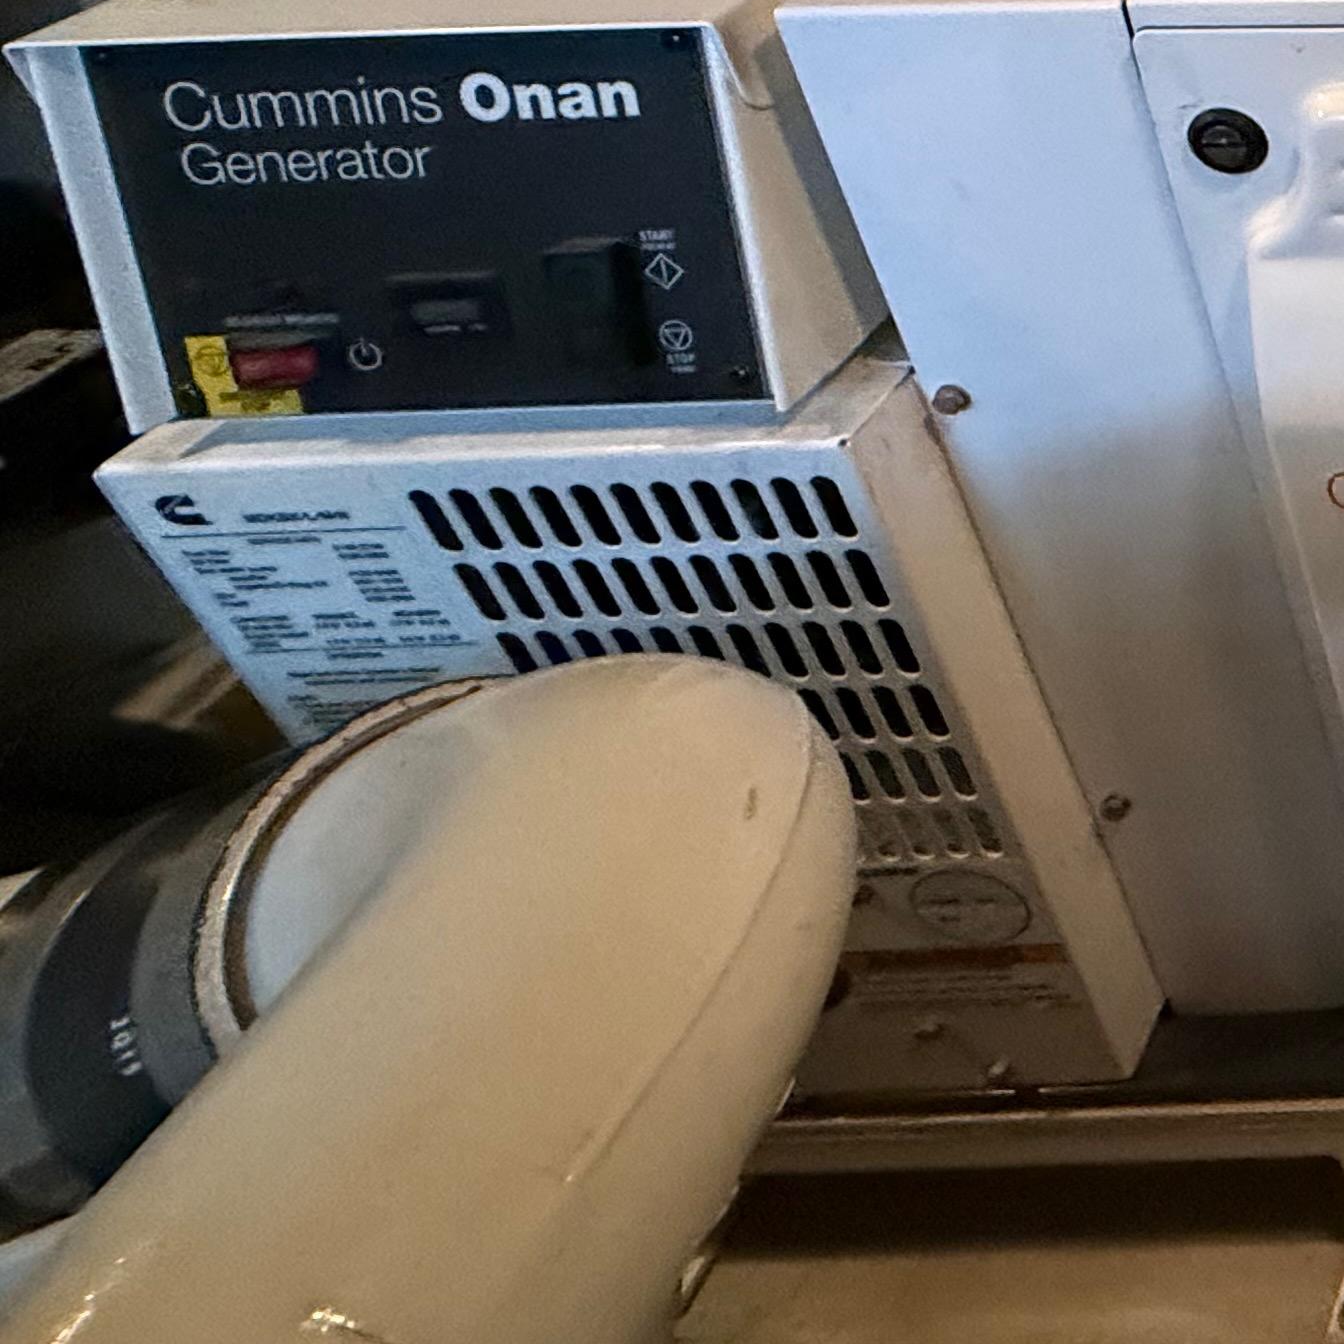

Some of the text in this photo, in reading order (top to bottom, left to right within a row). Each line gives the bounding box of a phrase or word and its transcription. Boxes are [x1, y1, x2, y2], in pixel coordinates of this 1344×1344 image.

[162, 70, 642, 133] Cummins Onan
[180, 140, 434, 186] Generator
